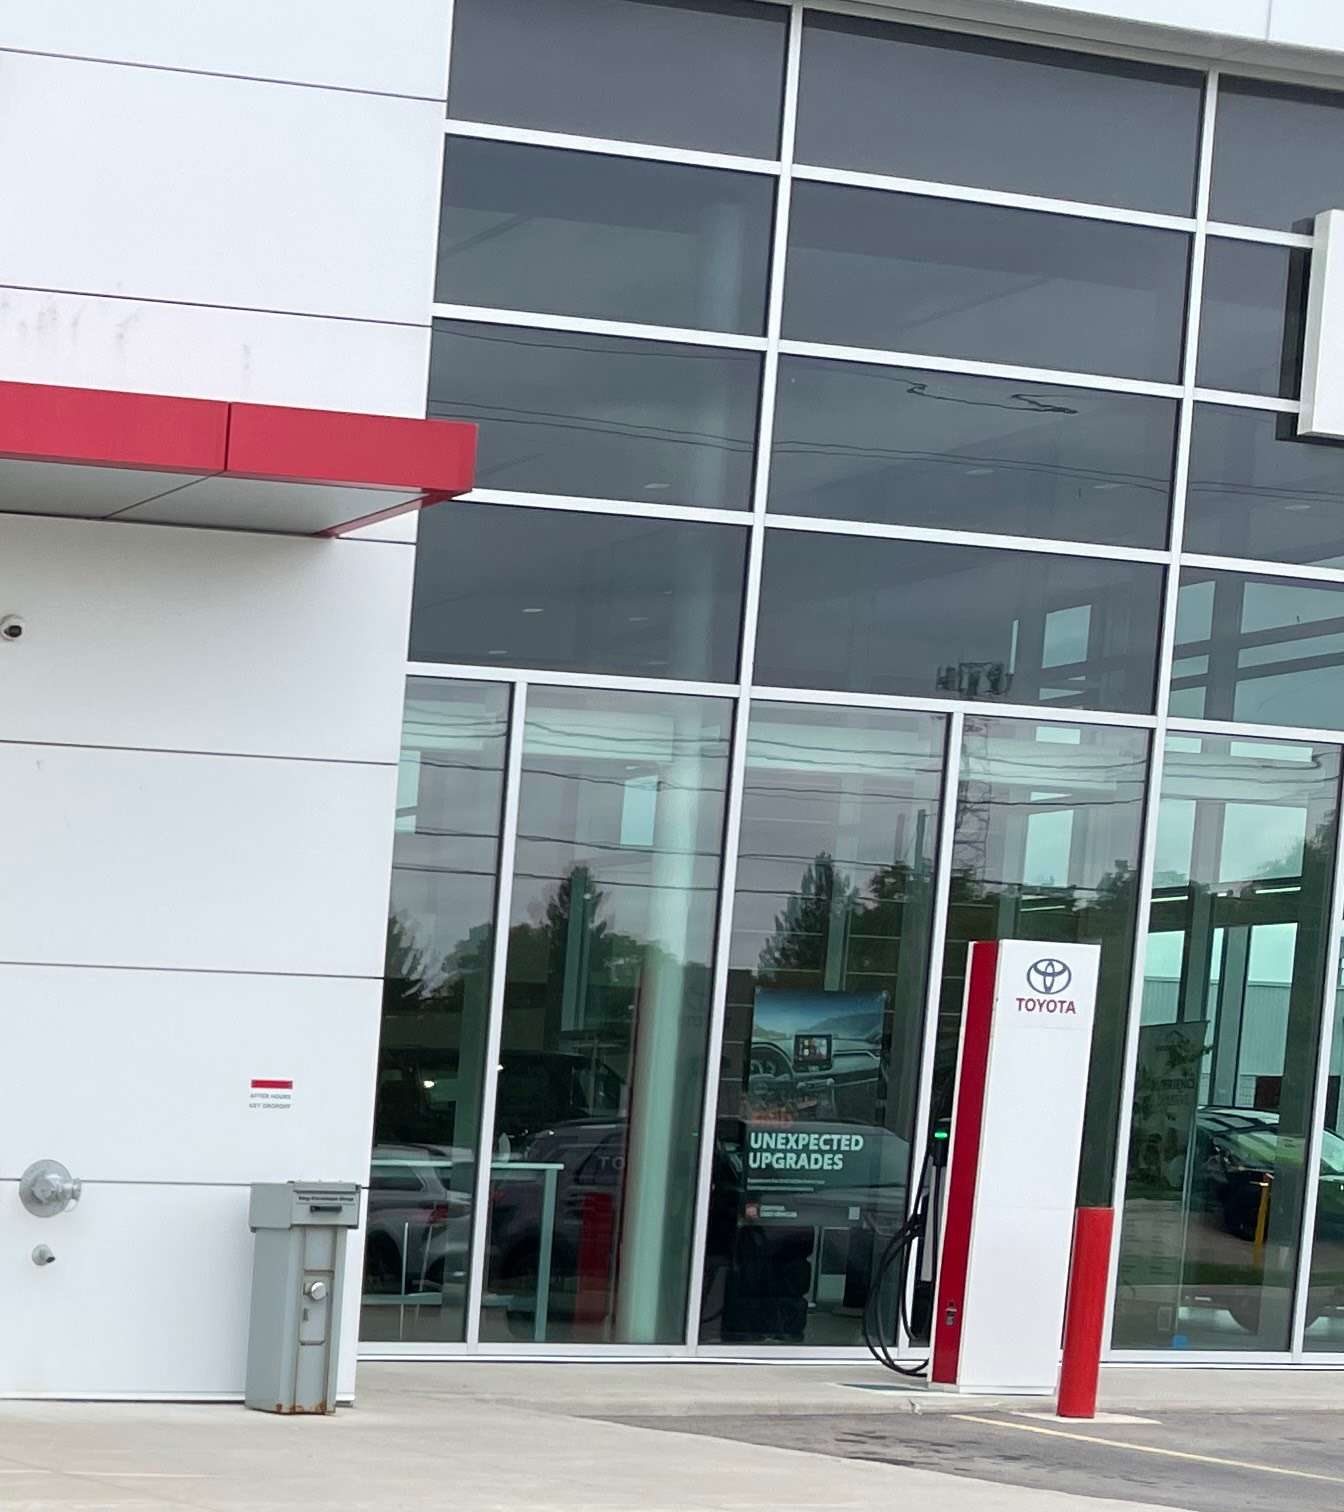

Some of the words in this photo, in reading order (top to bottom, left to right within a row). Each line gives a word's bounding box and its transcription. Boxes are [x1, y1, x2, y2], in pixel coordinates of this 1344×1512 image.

[1015, 997, 1076, 1014] TOYOTA
[750, 1132, 864, 1151] UNEXPECTED
[748, 1152, 844, 1170] UPGRADES
